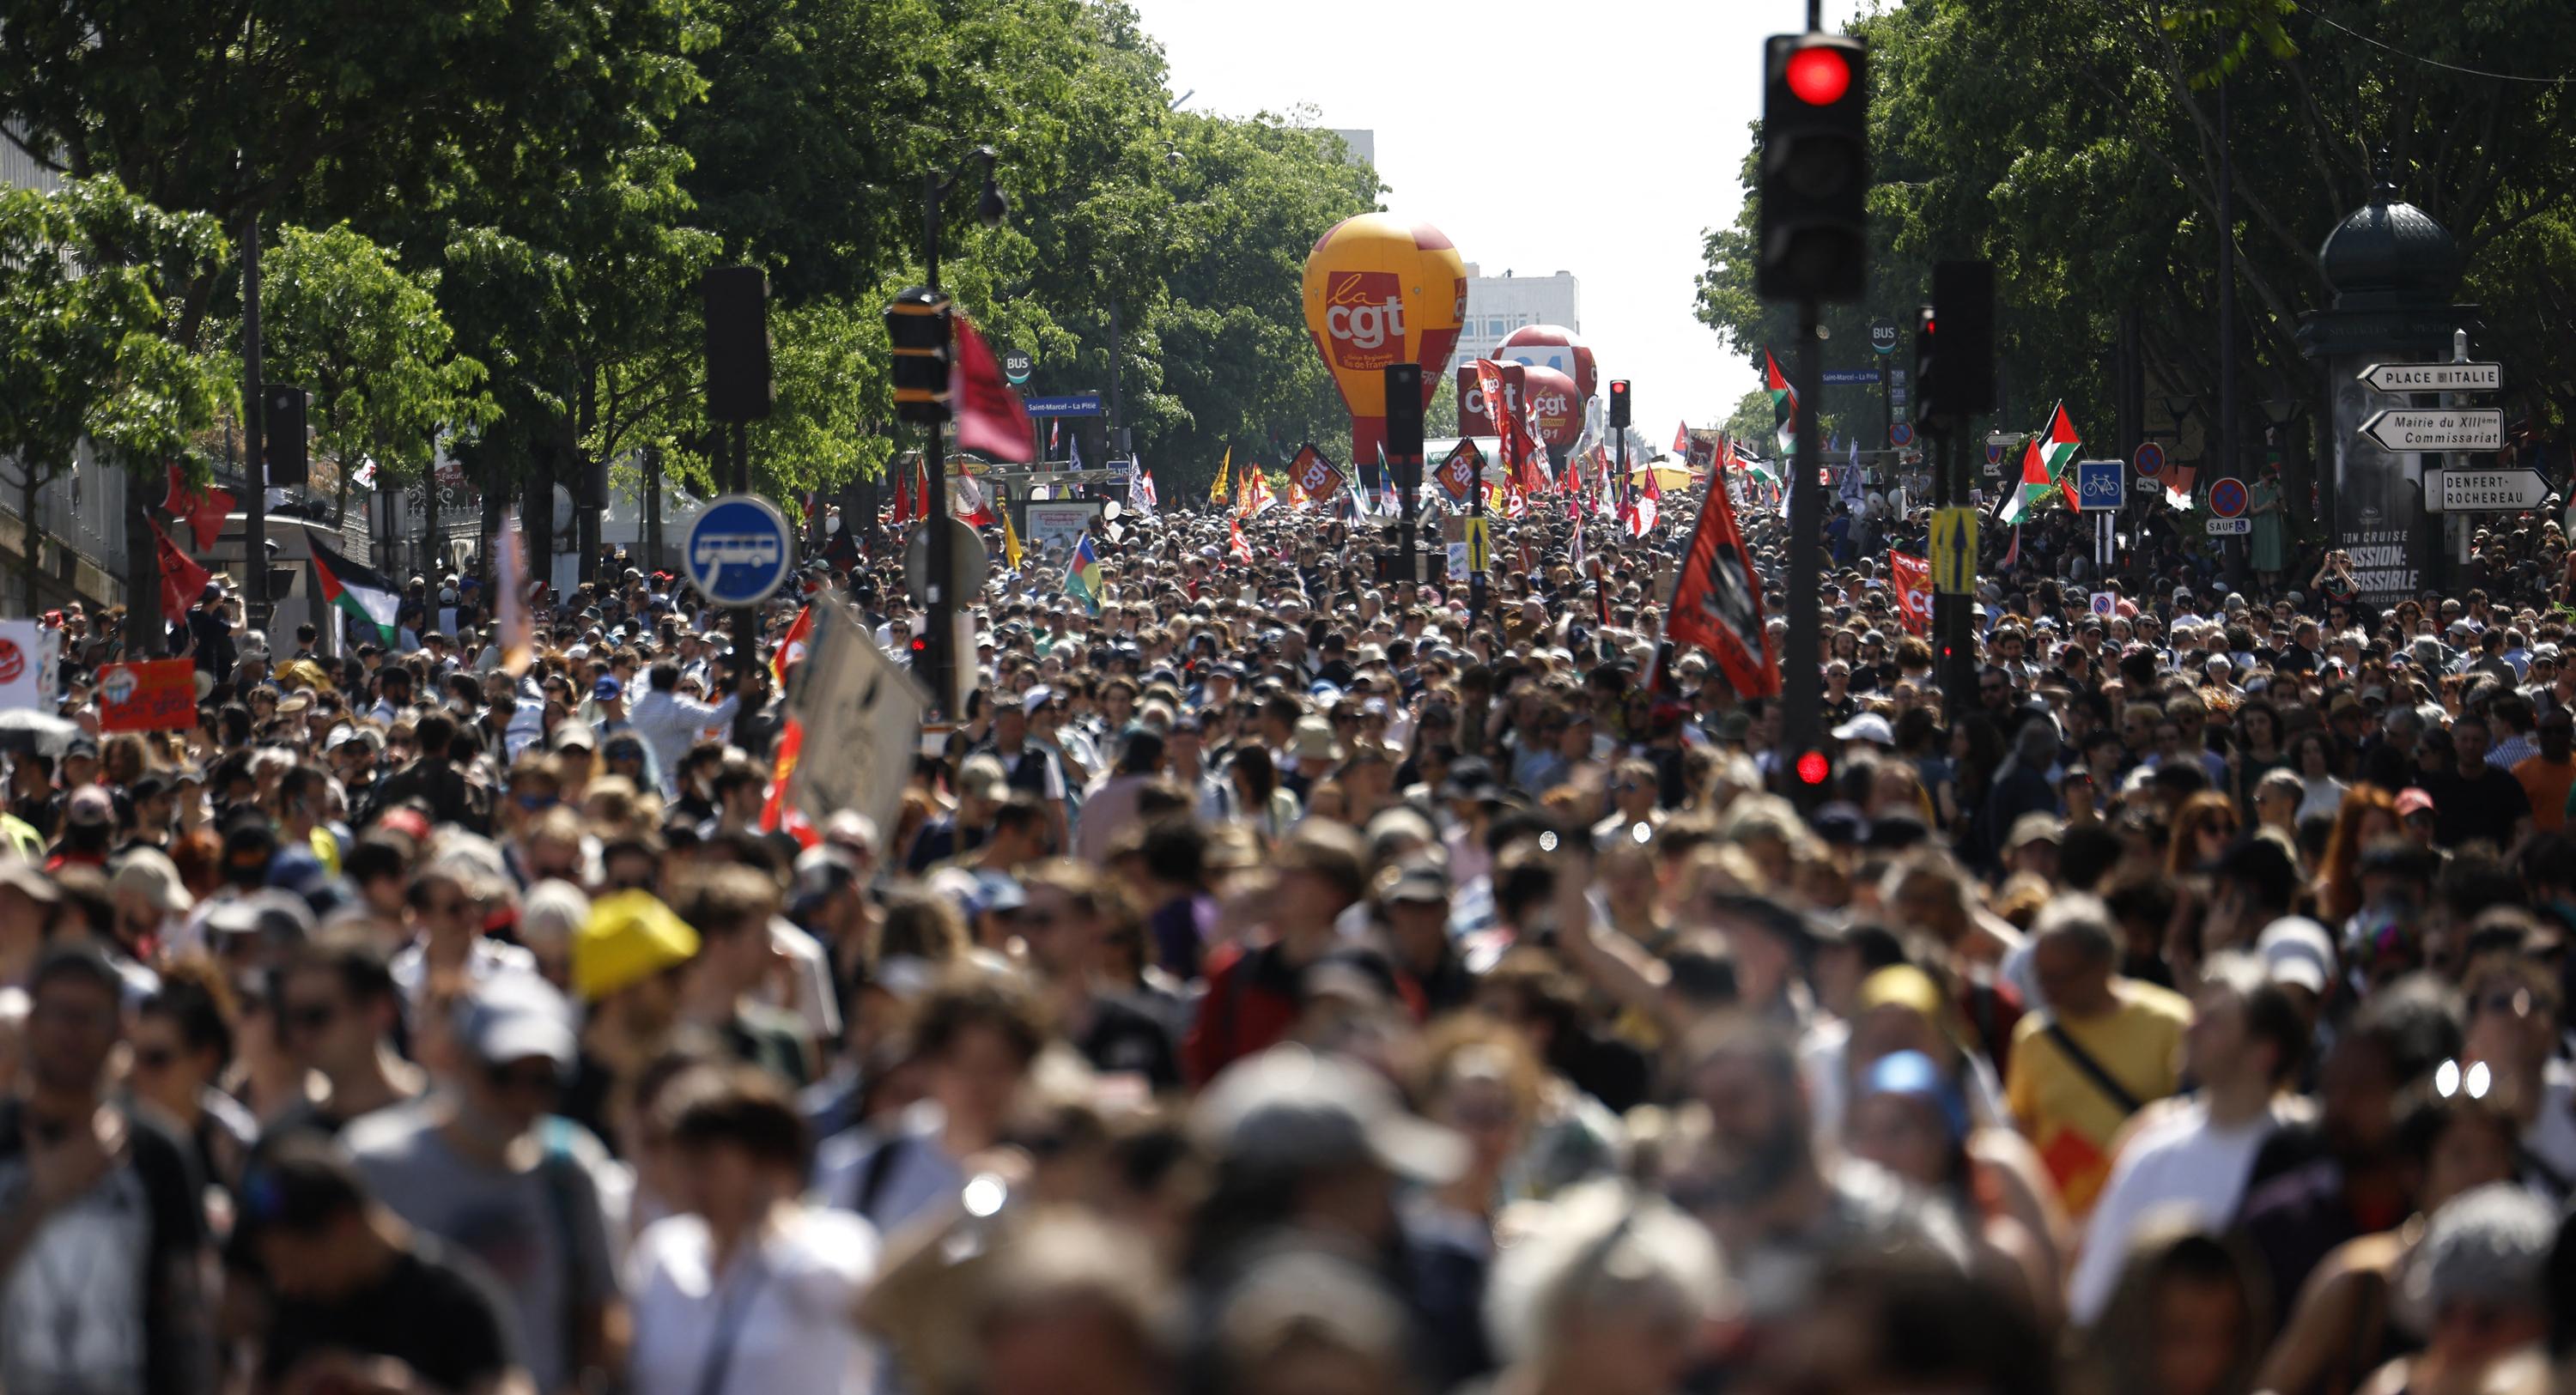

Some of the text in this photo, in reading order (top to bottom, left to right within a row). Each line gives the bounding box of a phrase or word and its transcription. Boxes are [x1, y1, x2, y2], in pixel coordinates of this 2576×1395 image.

[1327, 296, 1406, 349] cgt
[1873, 327, 1894, 339] BUS
[1006, 357, 1028, 369] BUS
[2386, 373, 2431, 384] PLACE
[1028, 403, 1066, 412] Saint-Marcel
[1465, 383, 1516, 420] ct
[1534, 393, 1568, 416] cgt
[2395, 416, 2433, 428] Mairie
[2439, 417, 2454, 428] du
[1542, 428, 1559, 440] 91
[2405, 432, 2498, 444] Commissariat
[1301, 457, 1329, 490] cgt
[2446, 476, 2509, 488] DENFERT-
[2446, 492, 2523, 504] ROCHEREAU
[2208, 521, 2234, 531] SAUF
[2342, 531, 2408, 543] TOM CRUISE
